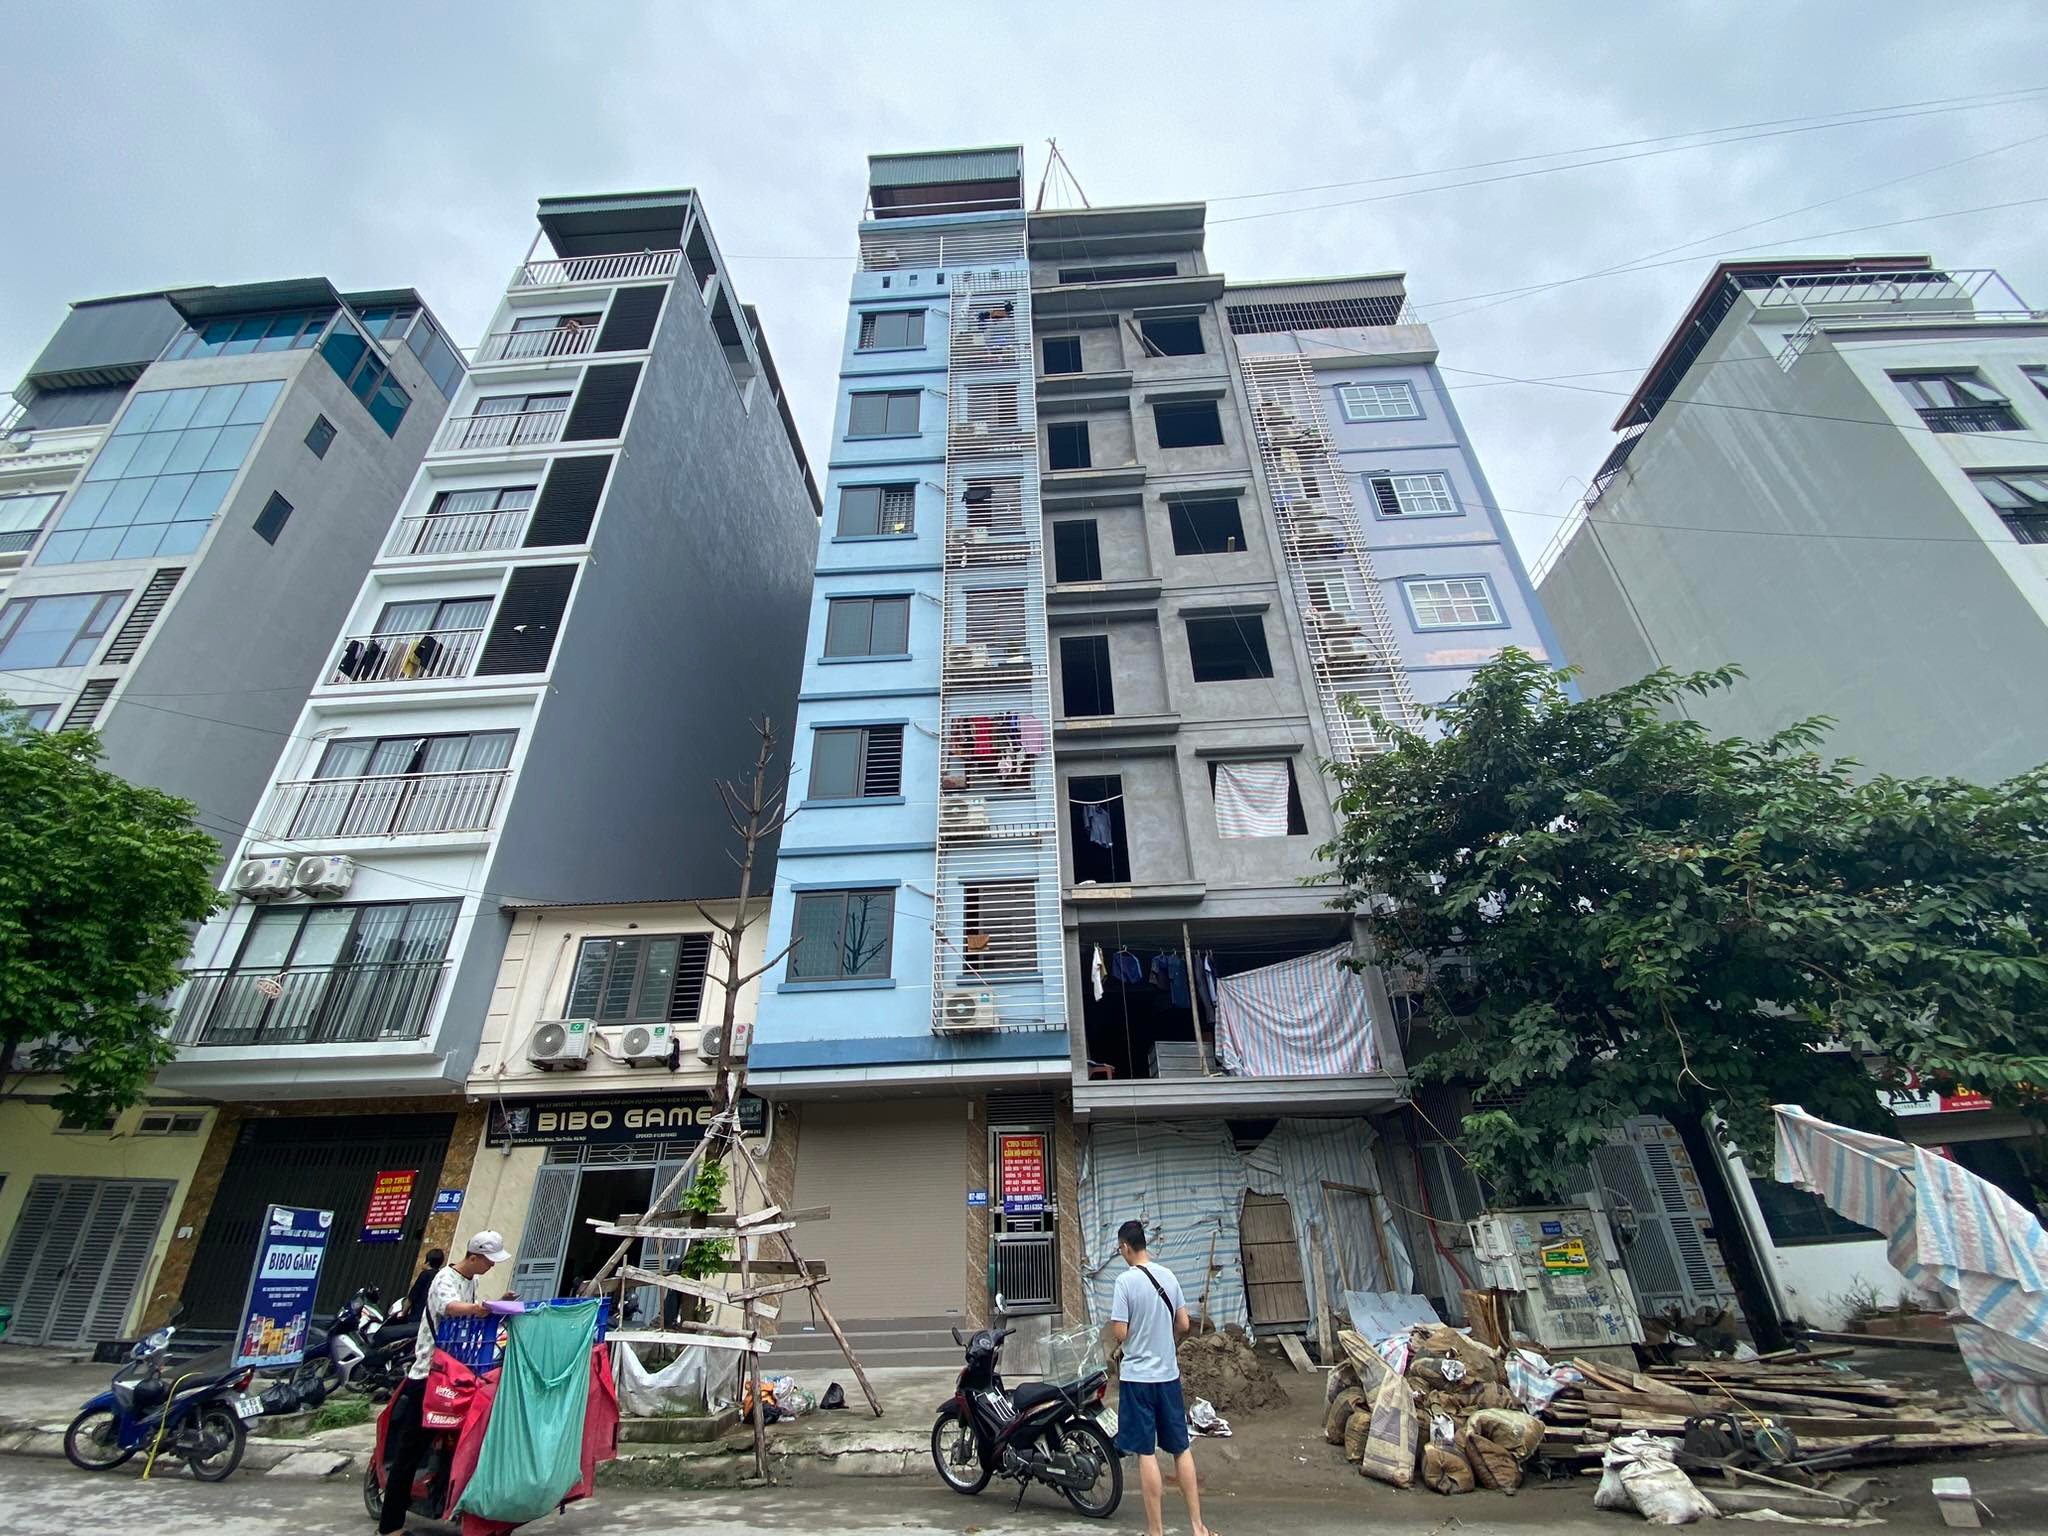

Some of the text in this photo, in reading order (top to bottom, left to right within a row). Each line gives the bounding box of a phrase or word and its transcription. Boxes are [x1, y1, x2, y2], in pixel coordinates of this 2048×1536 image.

[538, 1106, 712, 1131] BIBO GAME
[269, 1253, 318, 1270] BIBO GAME
